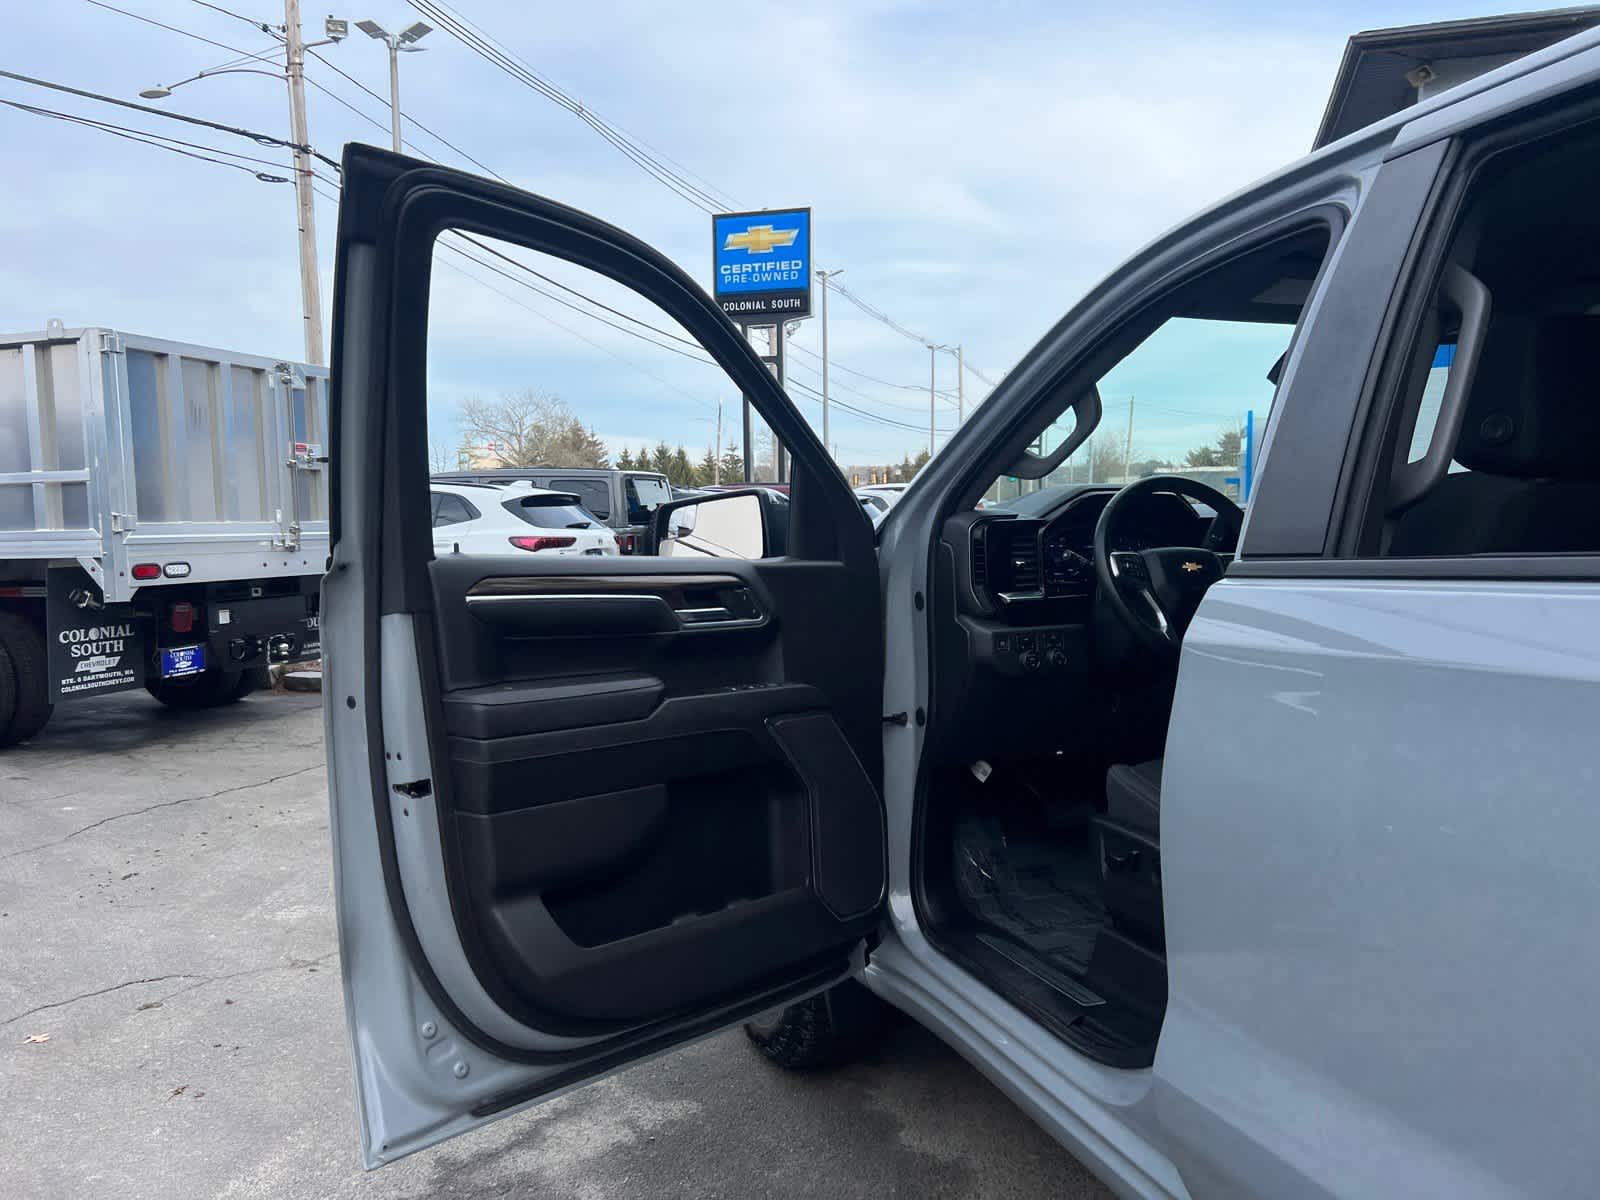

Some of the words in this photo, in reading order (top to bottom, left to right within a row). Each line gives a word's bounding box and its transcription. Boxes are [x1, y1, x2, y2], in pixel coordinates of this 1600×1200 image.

[721, 260, 802, 274] CERTIFIED
[725, 271, 798, 284] PRE-OWNED
[723, 301, 766, 311] COLONIAL
[772, 299, 801, 308] SOUTH
[59, 624, 134, 643] COLONIAL
[71, 640, 124, 657] SOUTH
